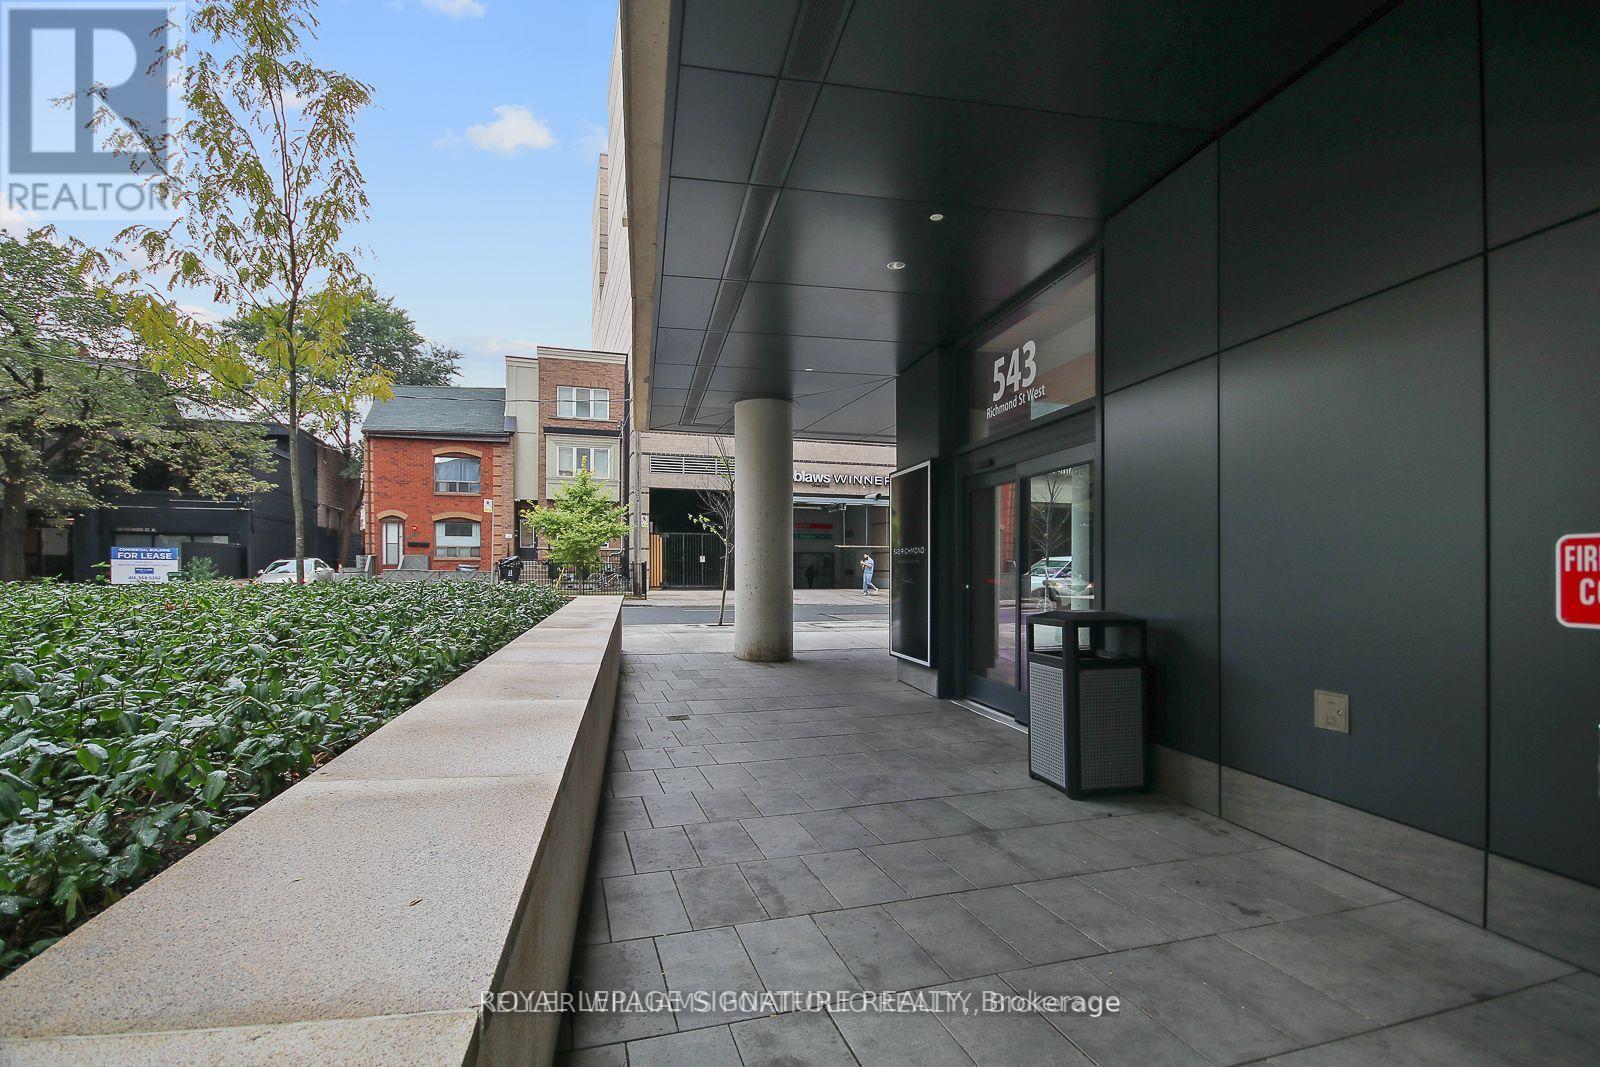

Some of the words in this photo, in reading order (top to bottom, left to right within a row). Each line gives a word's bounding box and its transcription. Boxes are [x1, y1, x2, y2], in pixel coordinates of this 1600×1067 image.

[992, 340, 1037, 402] 543
[986, 395, 1018, 419] Richmond
[1018, 392, 1026, 406] St
[1026, 384, 1046, 402] West
[140, 552, 172, 560] LEASE
[1564, 543, 1600, 573] FIR
[1579, 577, 1600, 606] C
